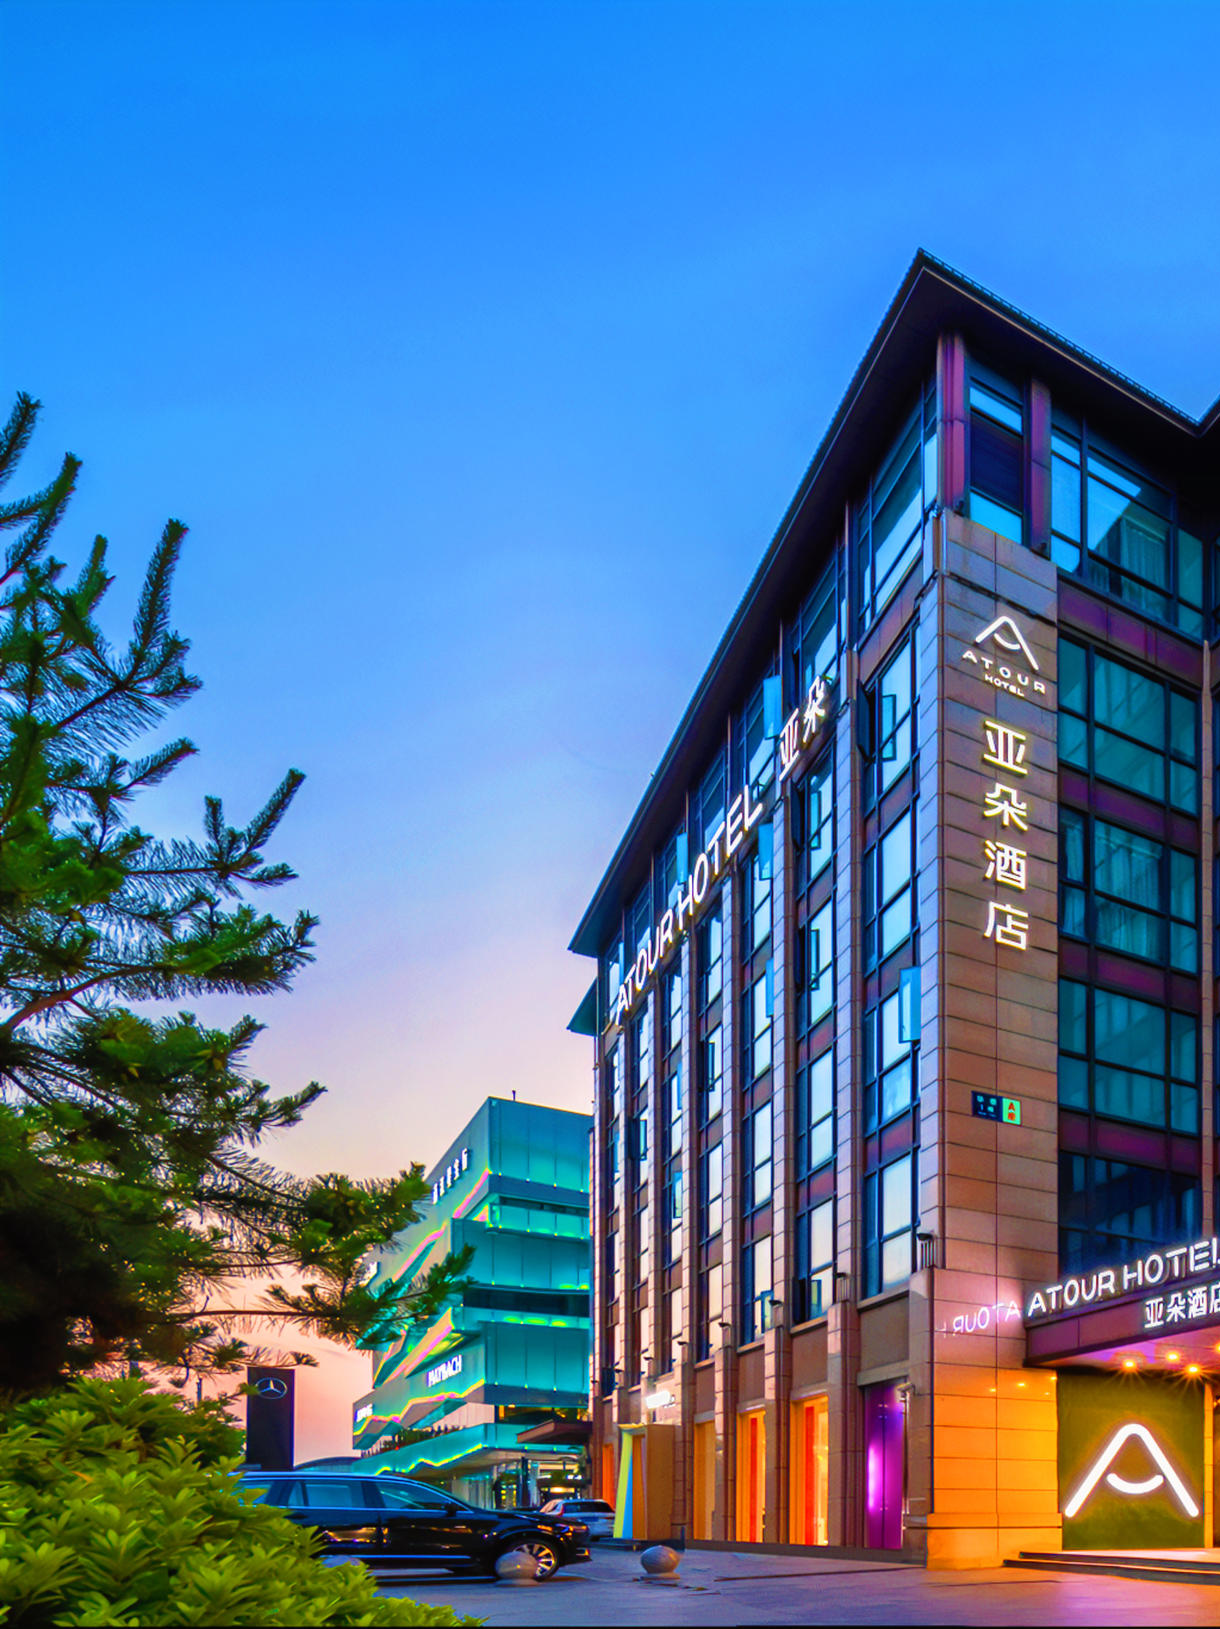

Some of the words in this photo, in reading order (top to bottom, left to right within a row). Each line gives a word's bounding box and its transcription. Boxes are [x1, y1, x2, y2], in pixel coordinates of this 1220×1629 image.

[962, 650, 1046, 694] ATOUR
[984, 673, 1025, 698] HOTEL
[779, 675, 826, 782] 亚朵
[983, 719, 1029, 952] 亚朵酒店
[616, 907, 673, 1026] ATOUR
[678, 785, 763, 931] HOTEL
[1027, 1270, 1115, 1317] ATOUR
